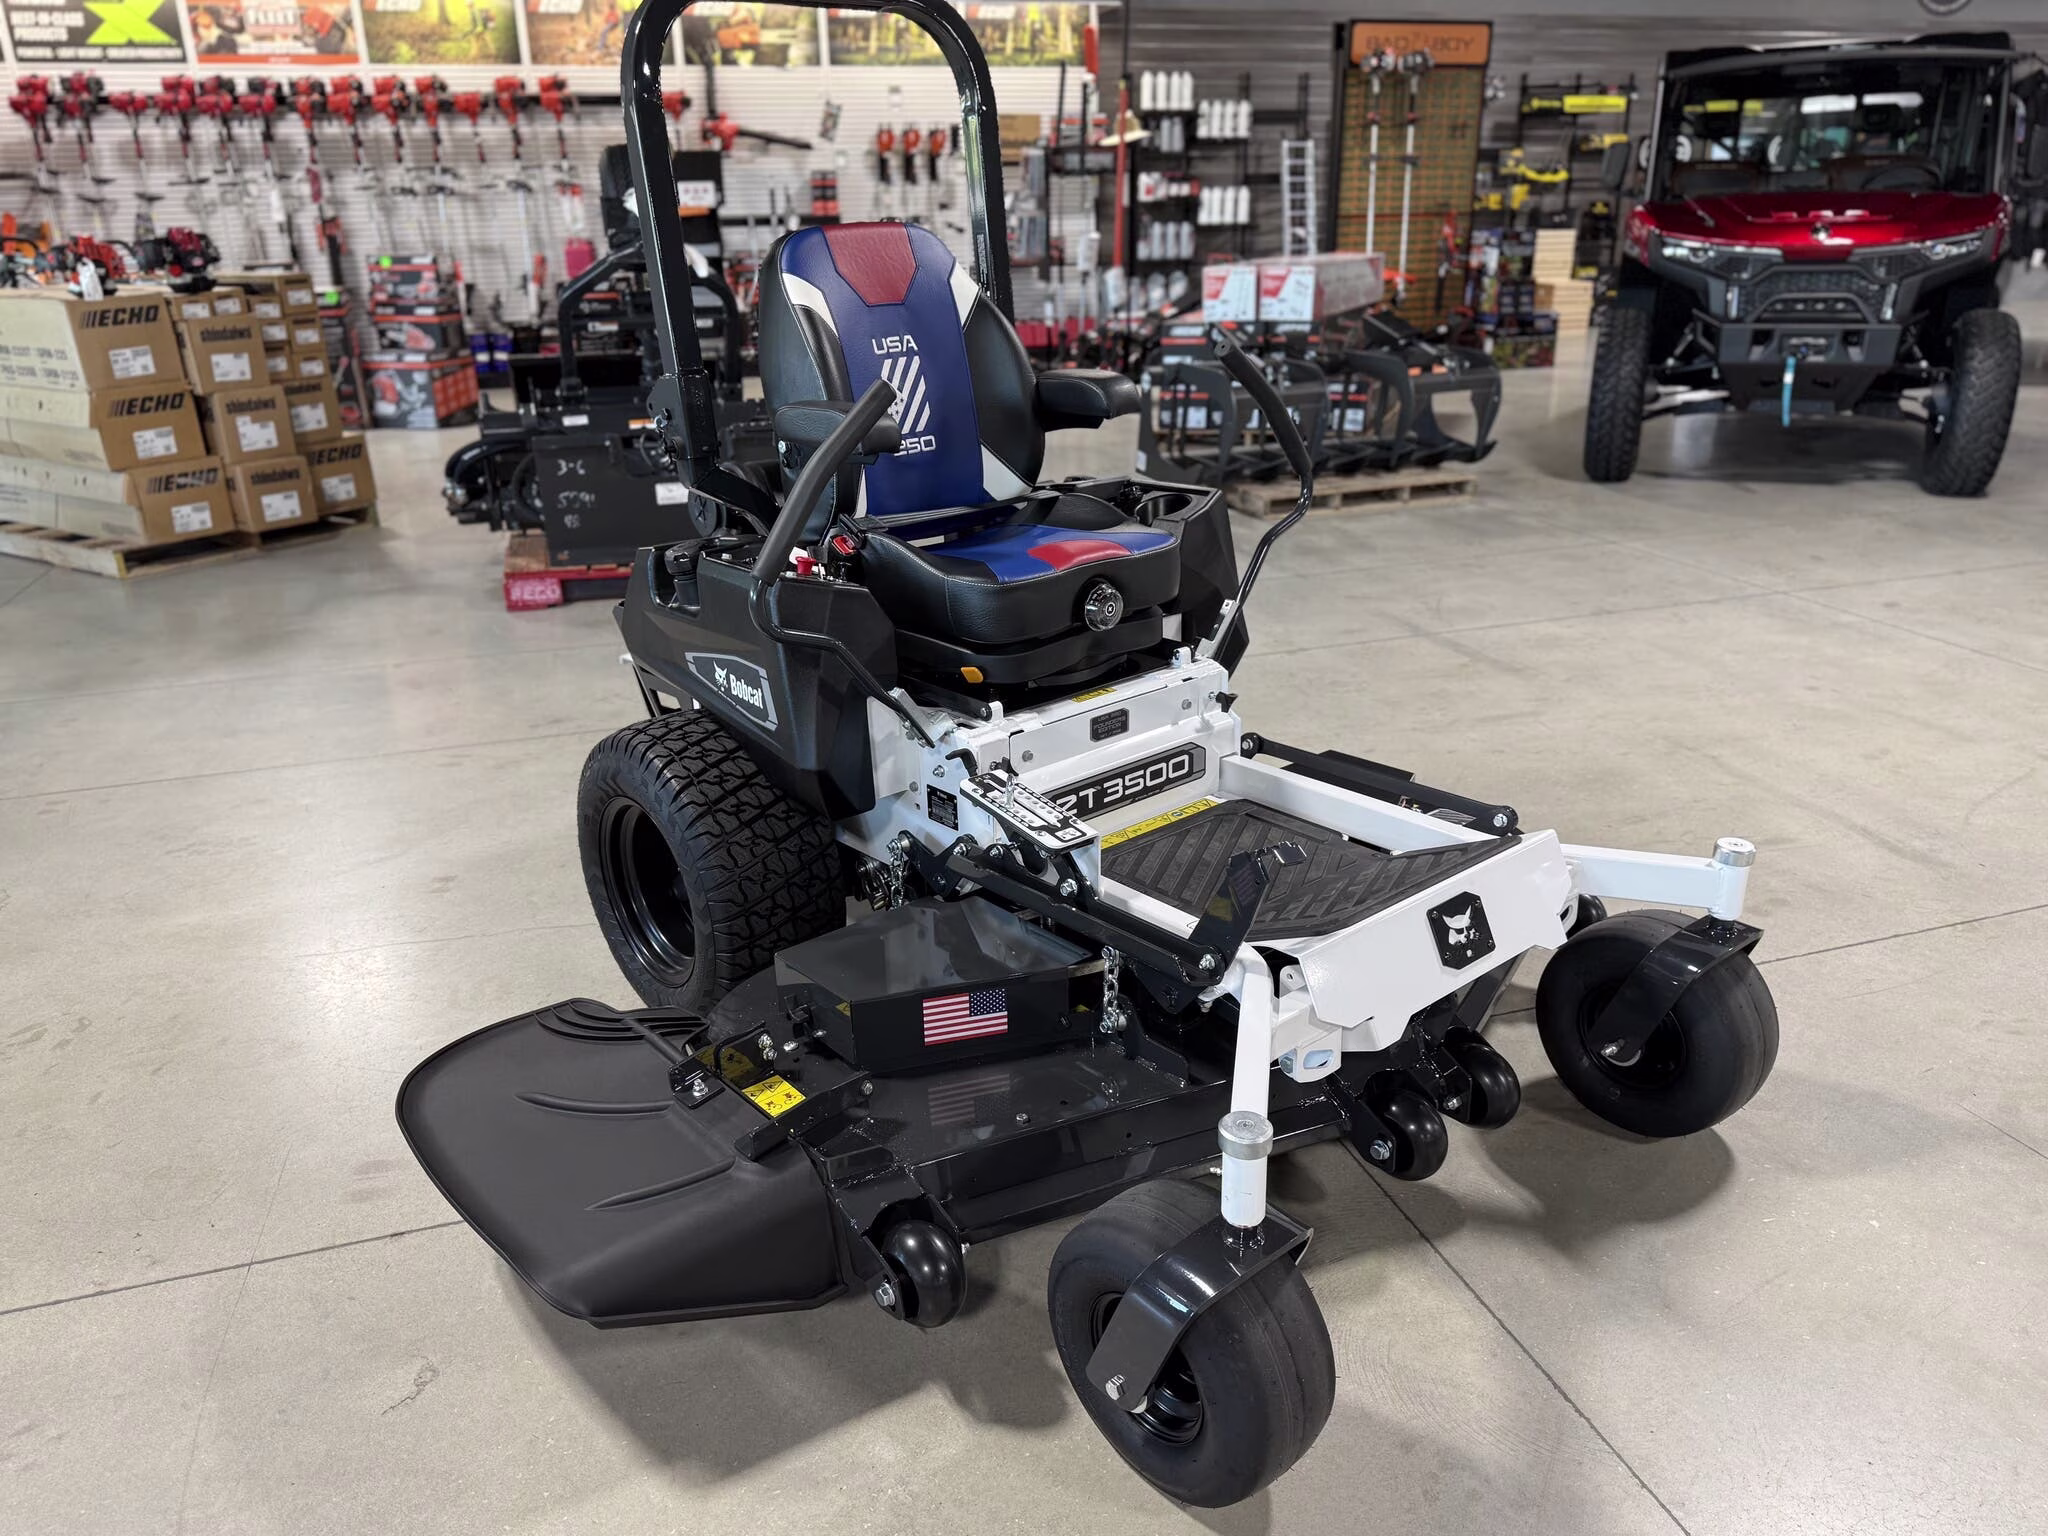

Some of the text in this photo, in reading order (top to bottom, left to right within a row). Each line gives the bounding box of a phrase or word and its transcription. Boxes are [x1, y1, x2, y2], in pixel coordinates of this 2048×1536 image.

[98, 304, 160, 328] ECHO
[871, 334, 919, 355] USA
[126, 392, 186, 416] ECHO
[316, 443, 363, 466] ECHO
[729, 673, 764, 710] Bobcat
